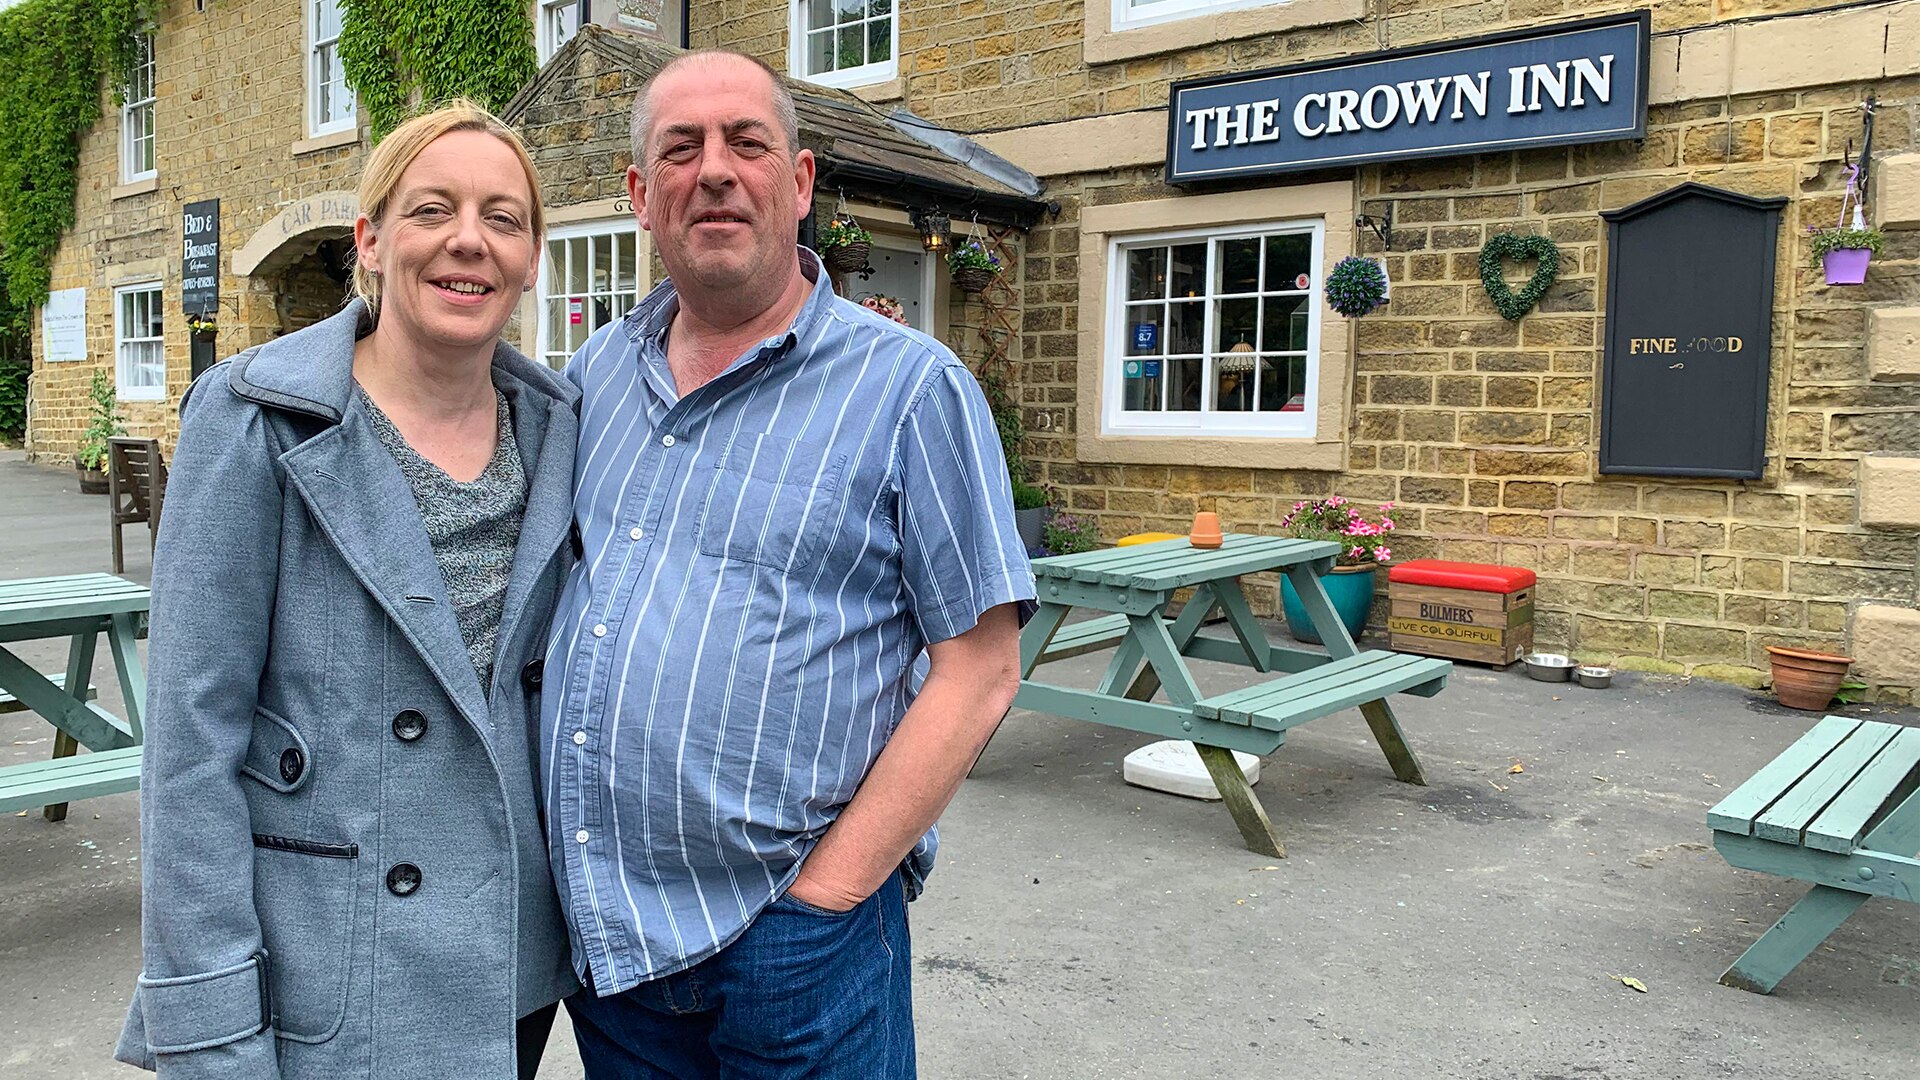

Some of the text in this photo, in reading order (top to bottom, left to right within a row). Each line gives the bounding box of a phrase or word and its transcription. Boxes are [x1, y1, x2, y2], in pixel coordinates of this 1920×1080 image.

[1186, 54, 1614, 150] THE CROWN INN
[184, 213, 212, 235] BED &
[282, 203, 311, 234] CAR
[184, 239, 218, 260] BREAKFAST
[1138, 332, 1152, 342] 8.7
[1630, 337, 1677, 355] FINE
[1420, 603, 1474, 623] BULMERS
[1391, 621, 1497, 642] LIVE COLOURFUL
